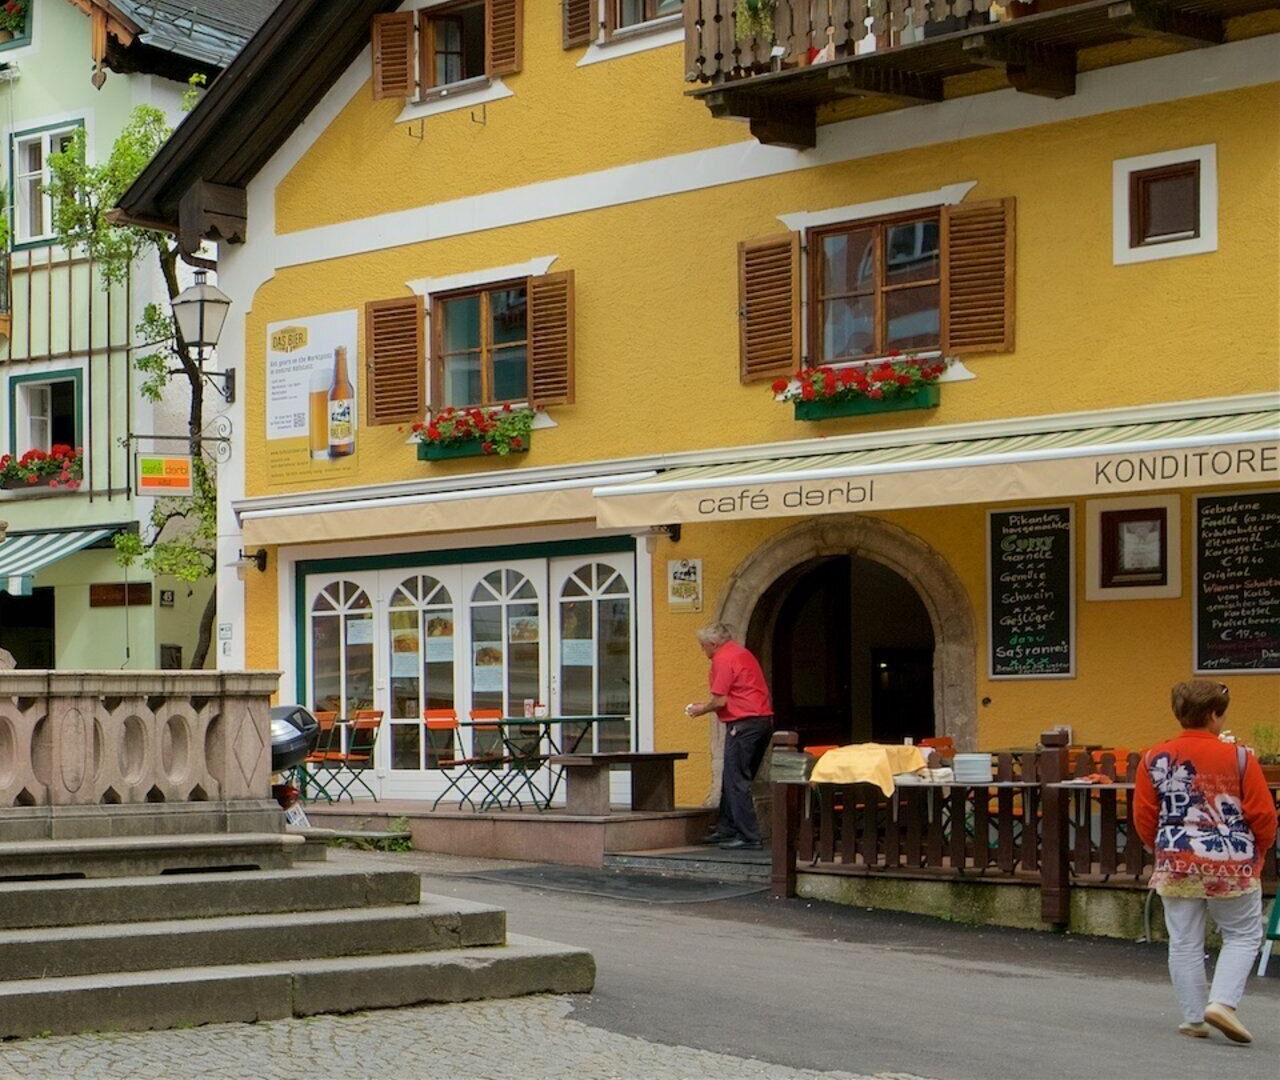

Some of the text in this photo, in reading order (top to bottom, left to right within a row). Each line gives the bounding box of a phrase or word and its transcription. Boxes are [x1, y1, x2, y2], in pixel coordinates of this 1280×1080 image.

[698, 487, 769, 515] café
[1001, 589, 1055, 604] Schwein
[1000, 611, 1055, 626] Geflügel
